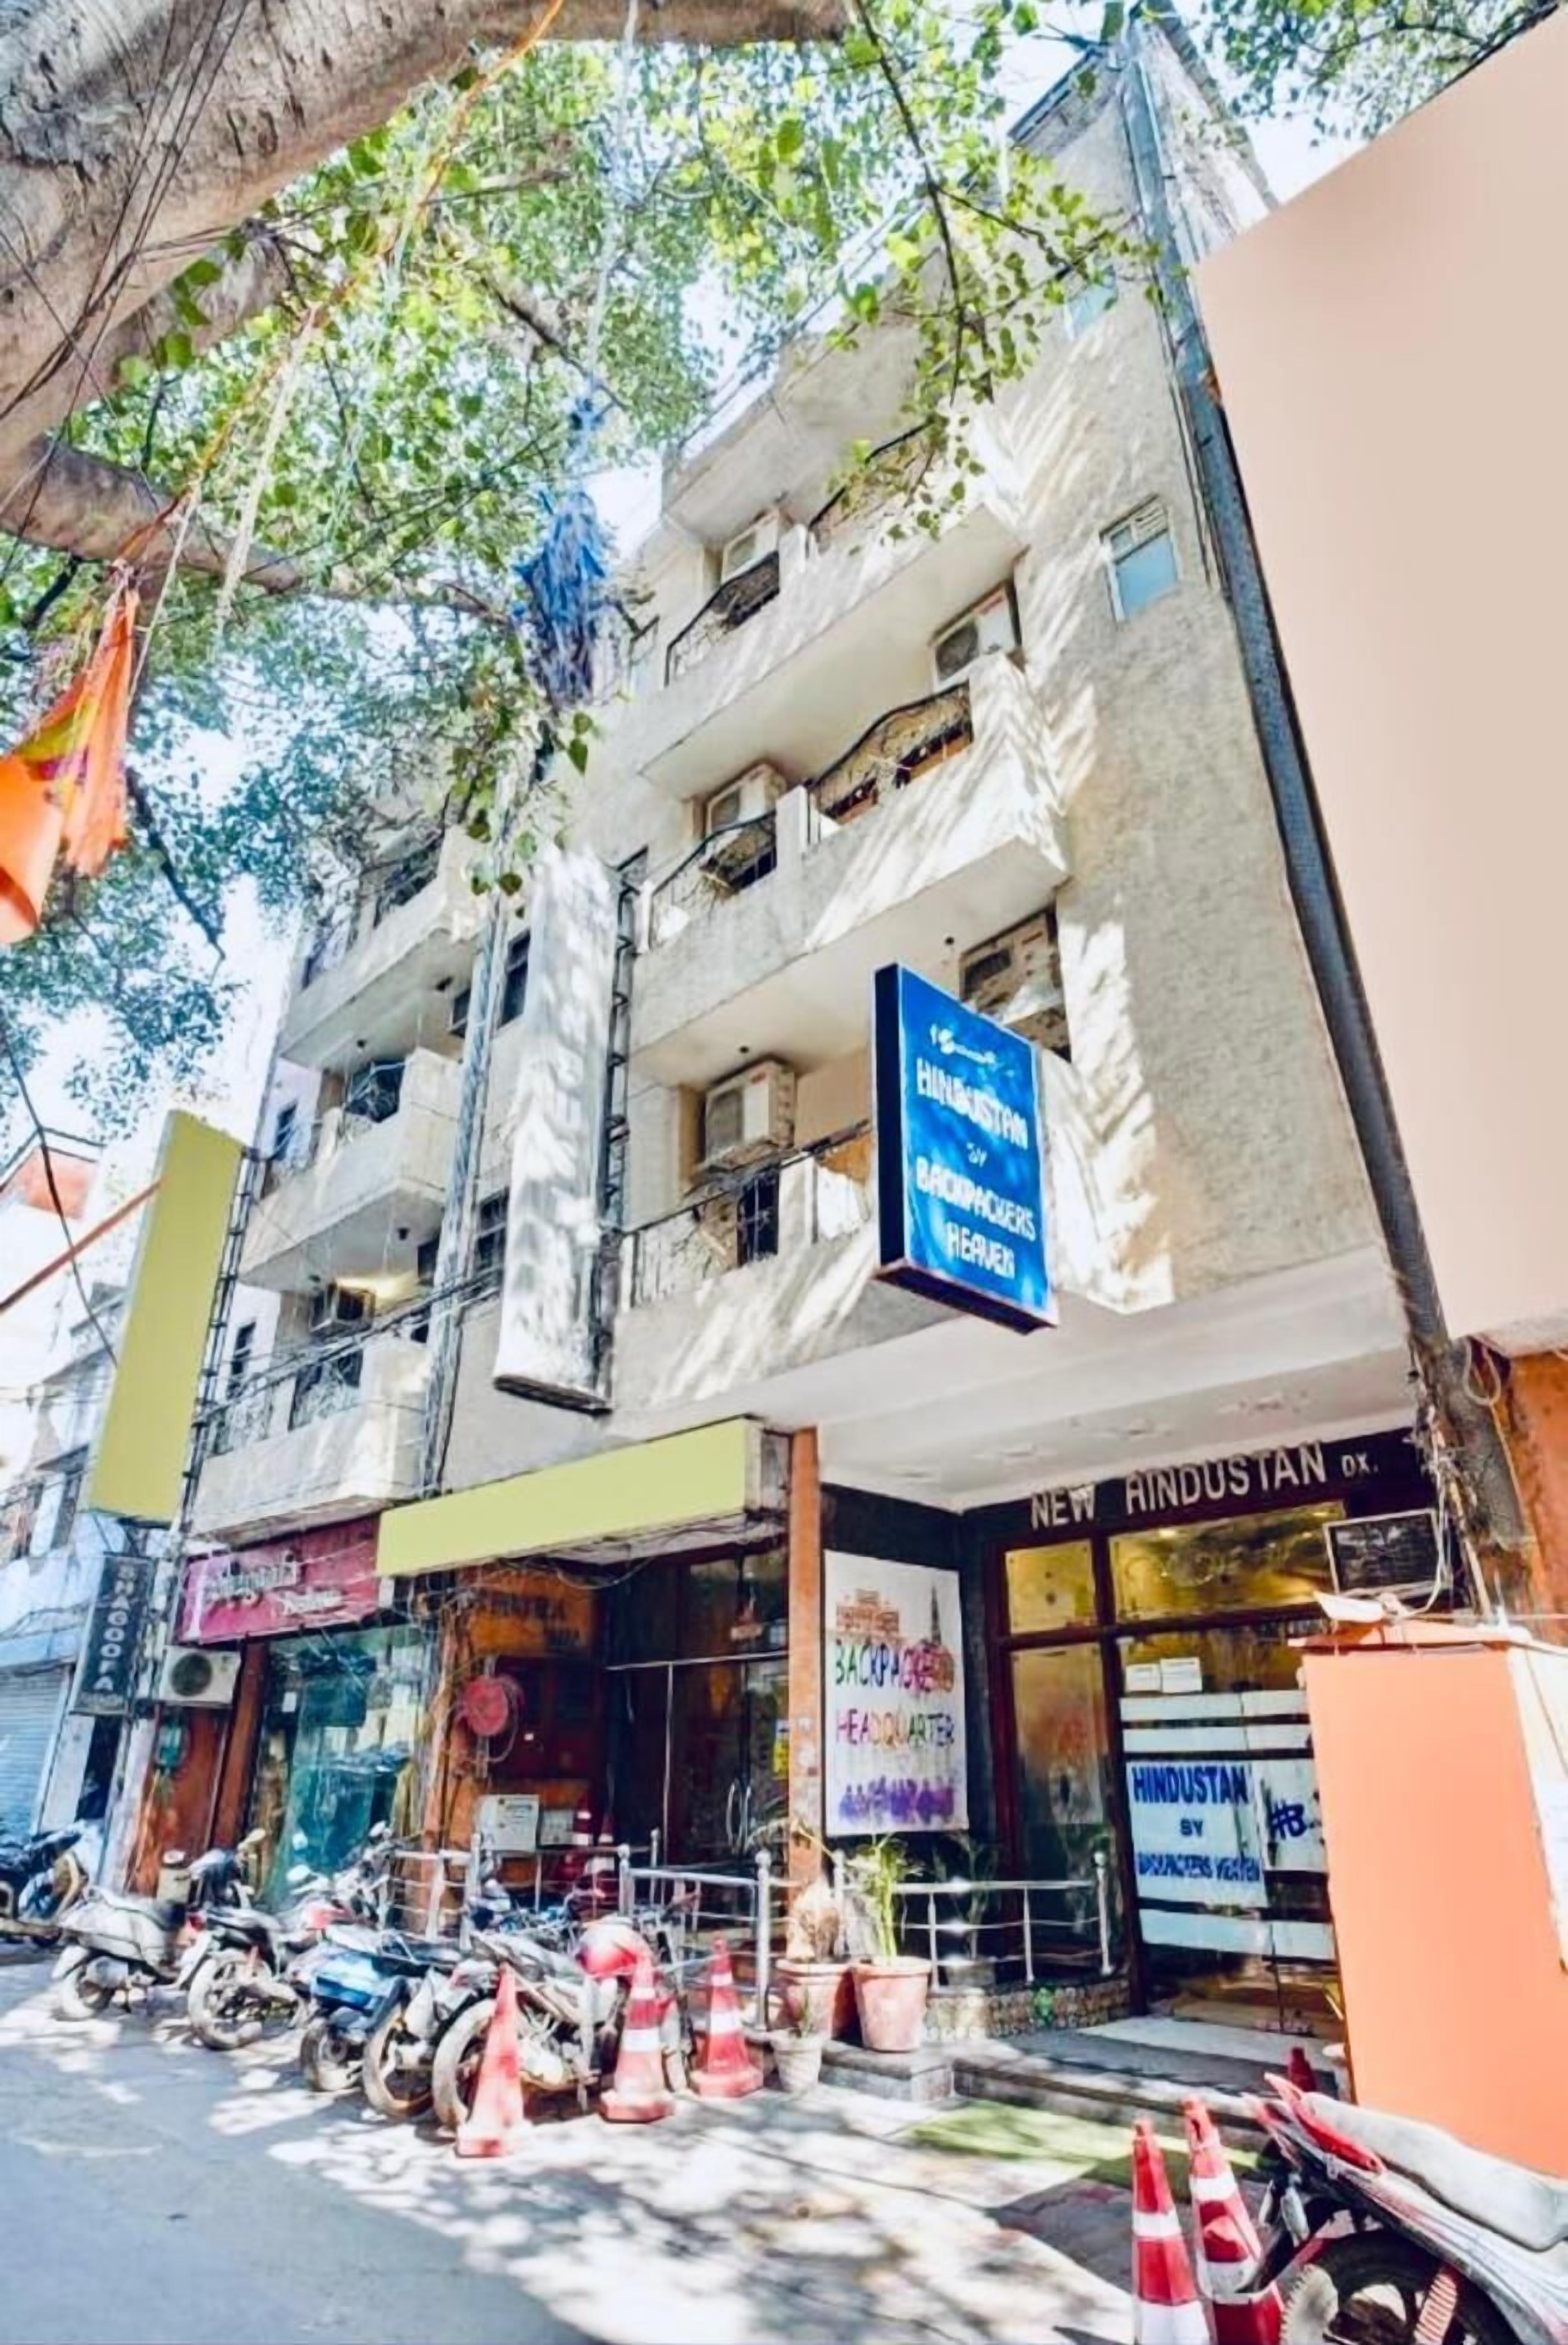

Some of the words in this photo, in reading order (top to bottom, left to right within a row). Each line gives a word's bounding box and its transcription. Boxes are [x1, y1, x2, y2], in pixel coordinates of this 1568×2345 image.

[1031, 1484, 1095, 1530] NEW
[1126, 1441, 1326, 1515] HINDUSTAN
[1131, 1766, 1249, 1804] HINDUSTAN
[1180, 1818, 1203, 1836] BY
